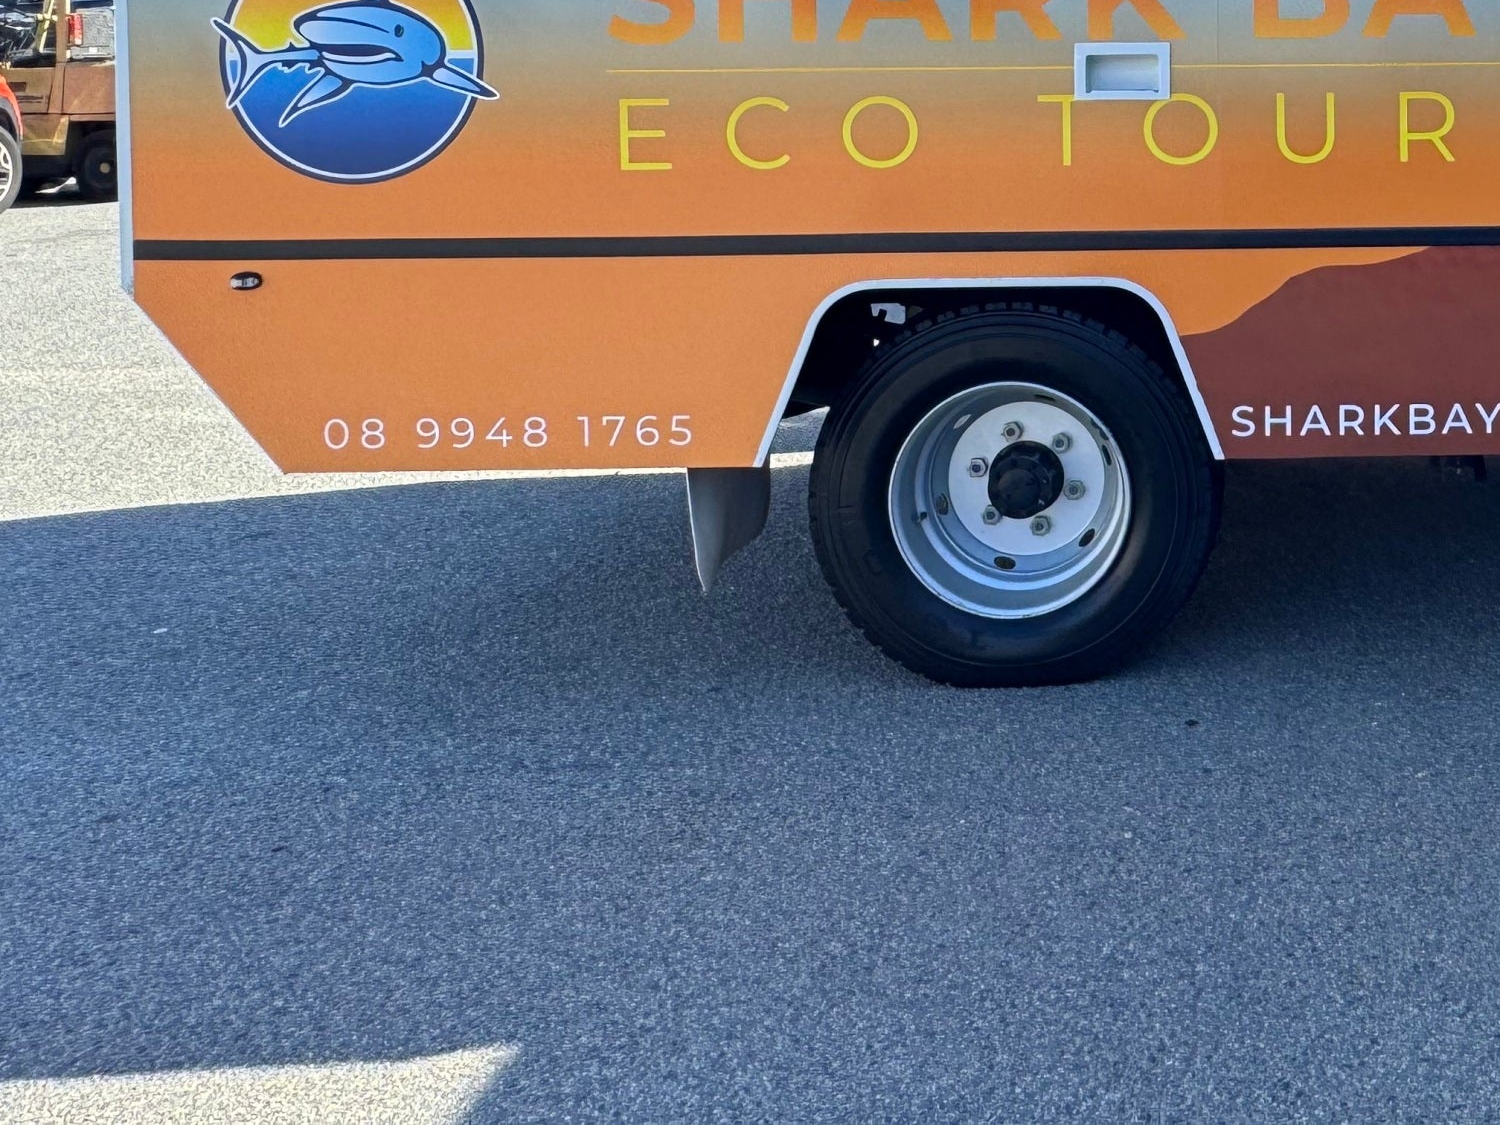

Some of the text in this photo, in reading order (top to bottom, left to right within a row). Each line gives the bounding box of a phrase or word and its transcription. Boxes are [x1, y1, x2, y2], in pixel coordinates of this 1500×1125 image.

[618, 95, 919, 171] ECO
[323, 414, 693, 451] 08 9948 1765
